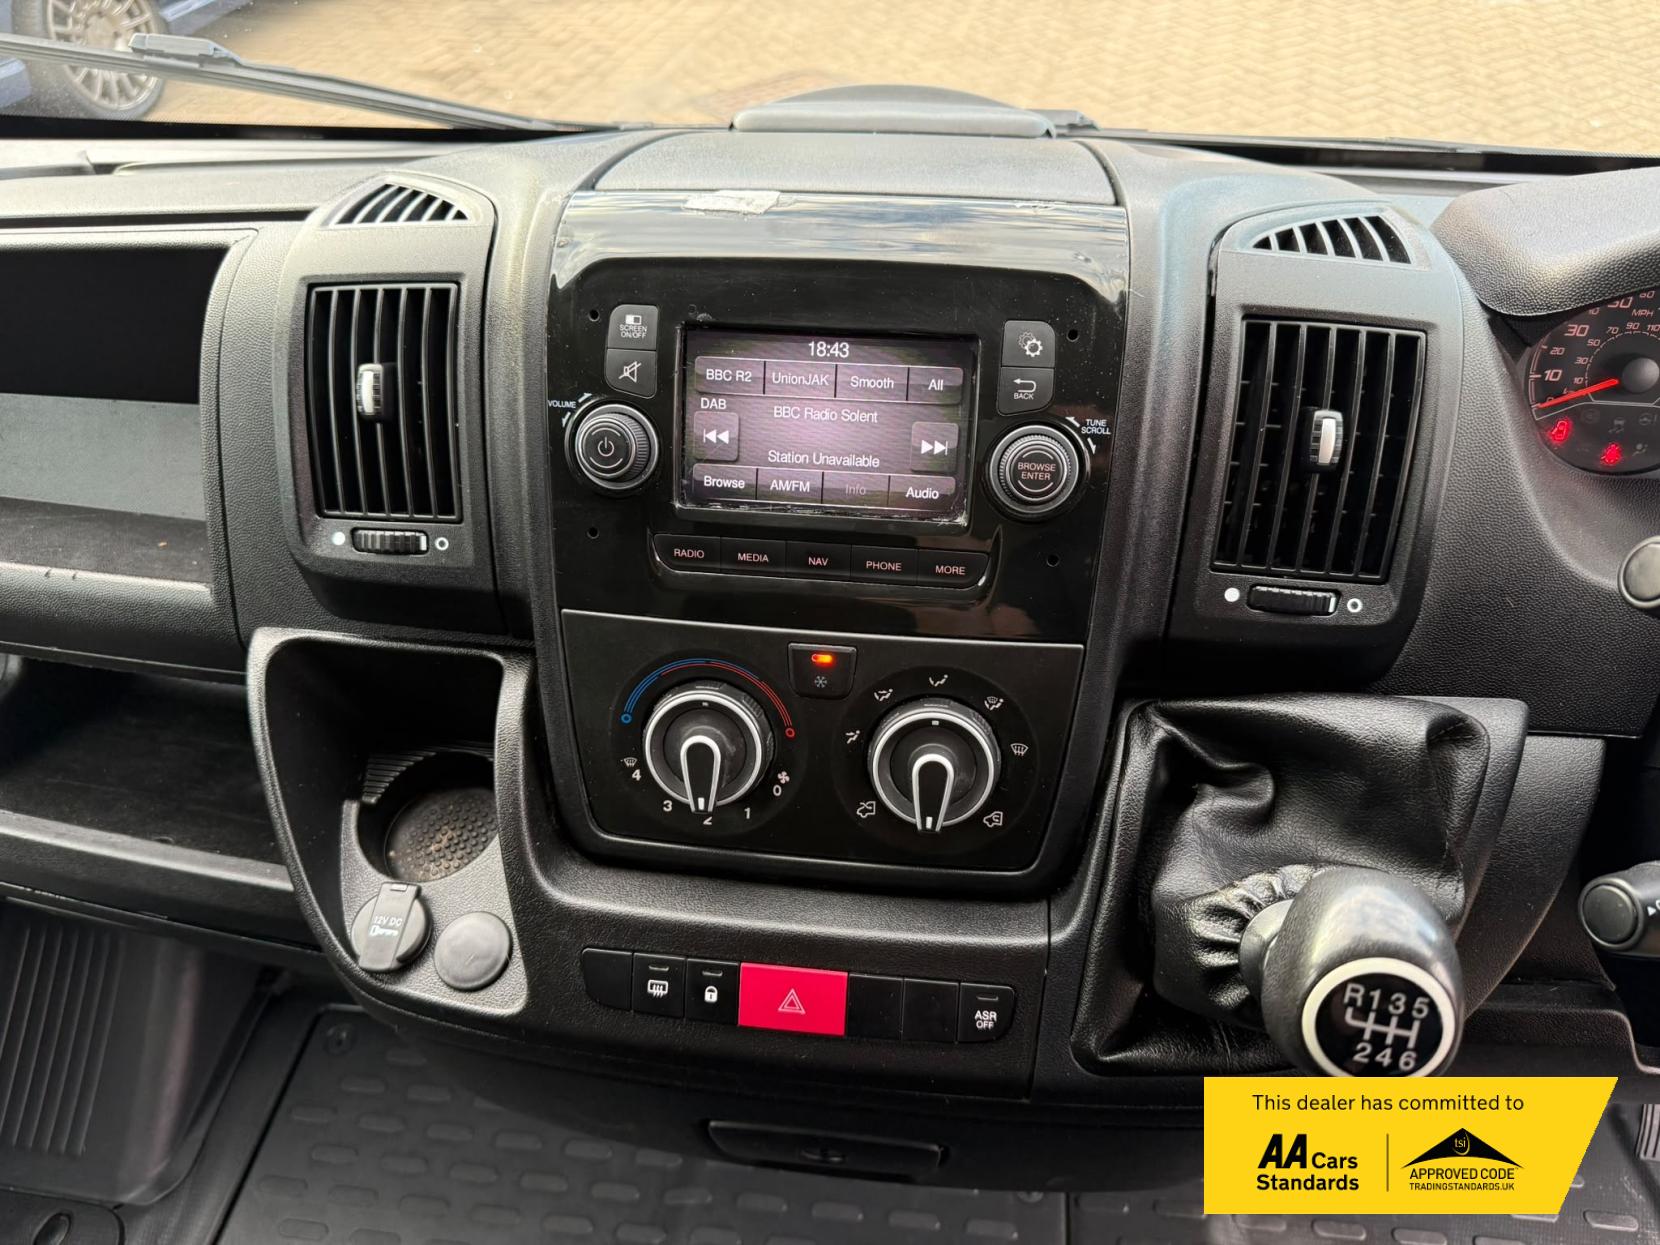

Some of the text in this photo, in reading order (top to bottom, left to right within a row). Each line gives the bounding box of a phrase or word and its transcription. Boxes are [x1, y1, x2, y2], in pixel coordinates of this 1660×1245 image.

[1631, 309, 1654, 317] MPH
[619, 324, 647, 332] SCREEN
[1564, 324, 1590, 337] 30
[1606, 326, 1619, 334] 70
[1626, 322, 1640, 330] 90
[620, 331, 647, 339] ON/OFF
[1587, 338, 1600, 347] 50
[807, 341, 850, 358] 18:43
[1550, 346, 1565, 355] 20
[1574, 357, 1589, 365] 30
[705, 368, 752, 382] BBC R2
[771, 372, 830, 387] UnionJAK
[1544, 369, 1563, 381] 10
[850, 375, 895, 390] Smooth
[927, 379, 944, 392] All
[1013, 392, 1035, 400] BACK
[547, 400, 576, 408] VOLUME
[700, 397, 727, 410] DAB
[773, 405, 878, 424] BBC Radio Solent
[1086, 419, 1107, 427] TUNE
[1081, 426, 1112, 435] SCROLL
[767, 449, 880, 468] Station Unavailable
[1017, 461, 1057, 472] BROWSE
[1021, 471, 1051, 481] ENTER
[703, 475, 745, 490] Browse
[769, 479, 811, 493] AM/FM
[845, 483, 867, 496] Info
[905, 486, 940, 500] Audio
[673, 548, 705, 559] RADIO
[737, 552, 769, 563] MEDIA
[808, 556, 828, 567] NAV
[865, 560, 902, 572] PHONE
[935, 564, 966, 576] MORE
[631, 769, 642, 781] 4
[772, 784, 782, 797] 0
[662, 800, 673, 812] 3
[744, 807, 751, 819] 1
[702, 816, 713, 825] 2
[373, 915, 403, 927] 12V DC
[1343, 982, 1430, 1019] R 1 3 5
[974, 1010, 997, 1022] ASR
[975, 1020, 994, 1030] OFF
[1352, 1042, 1418, 1071] 2 4 6
